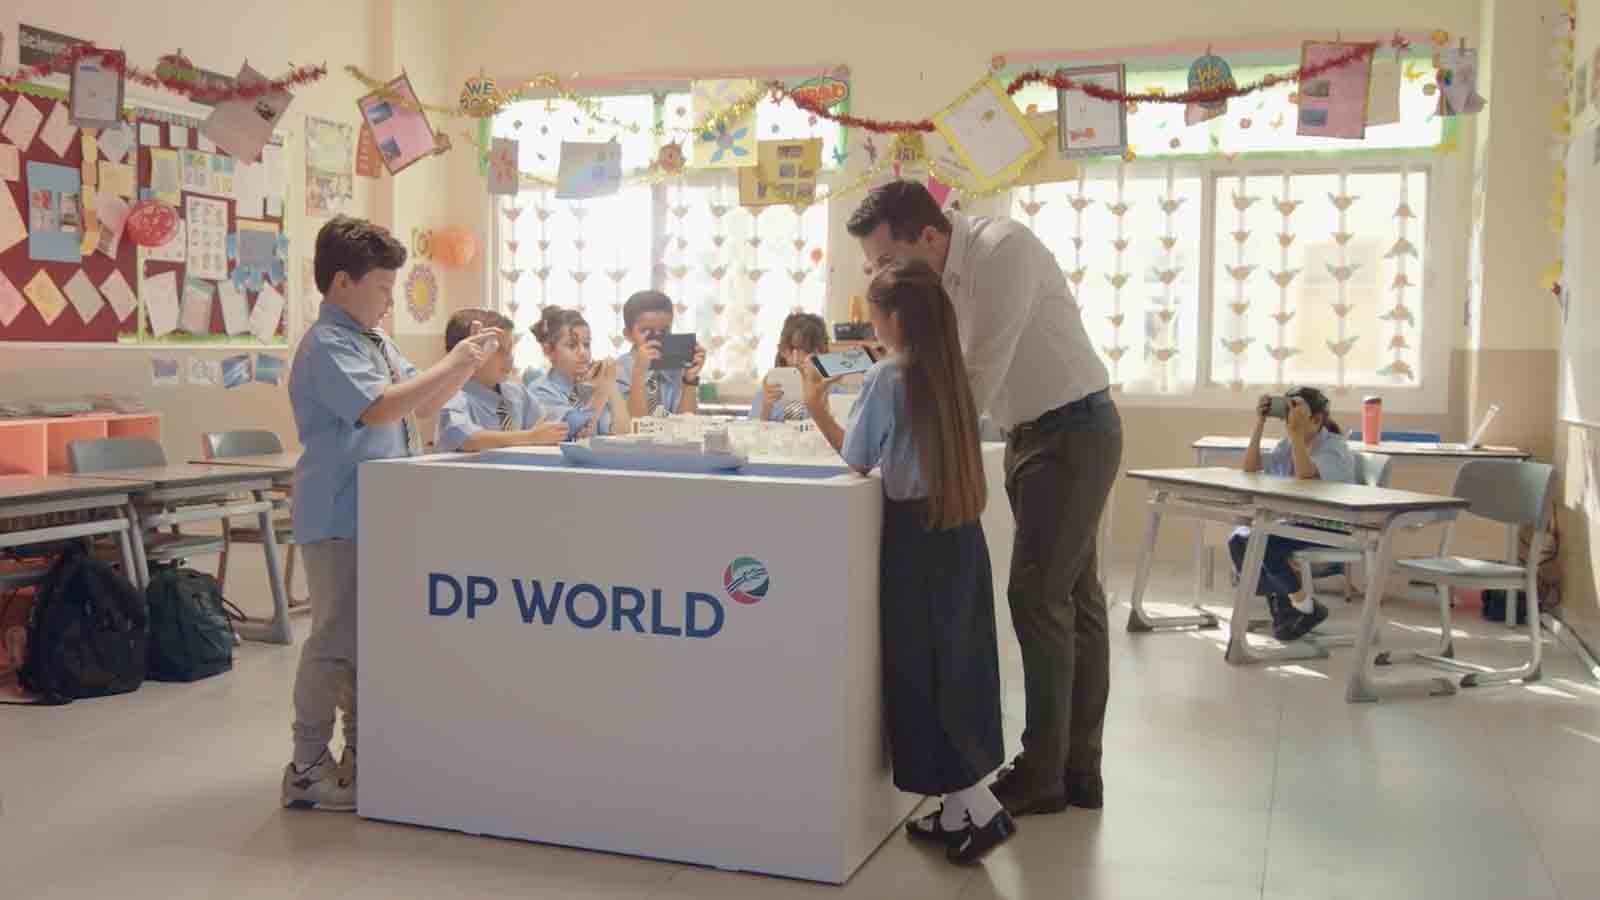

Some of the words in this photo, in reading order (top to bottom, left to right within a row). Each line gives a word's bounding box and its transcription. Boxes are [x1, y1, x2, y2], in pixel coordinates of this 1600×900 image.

[464, 80, 495, 95] WE
[428, 572, 498, 619] DP
[512, 578, 725, 638] WORLD
